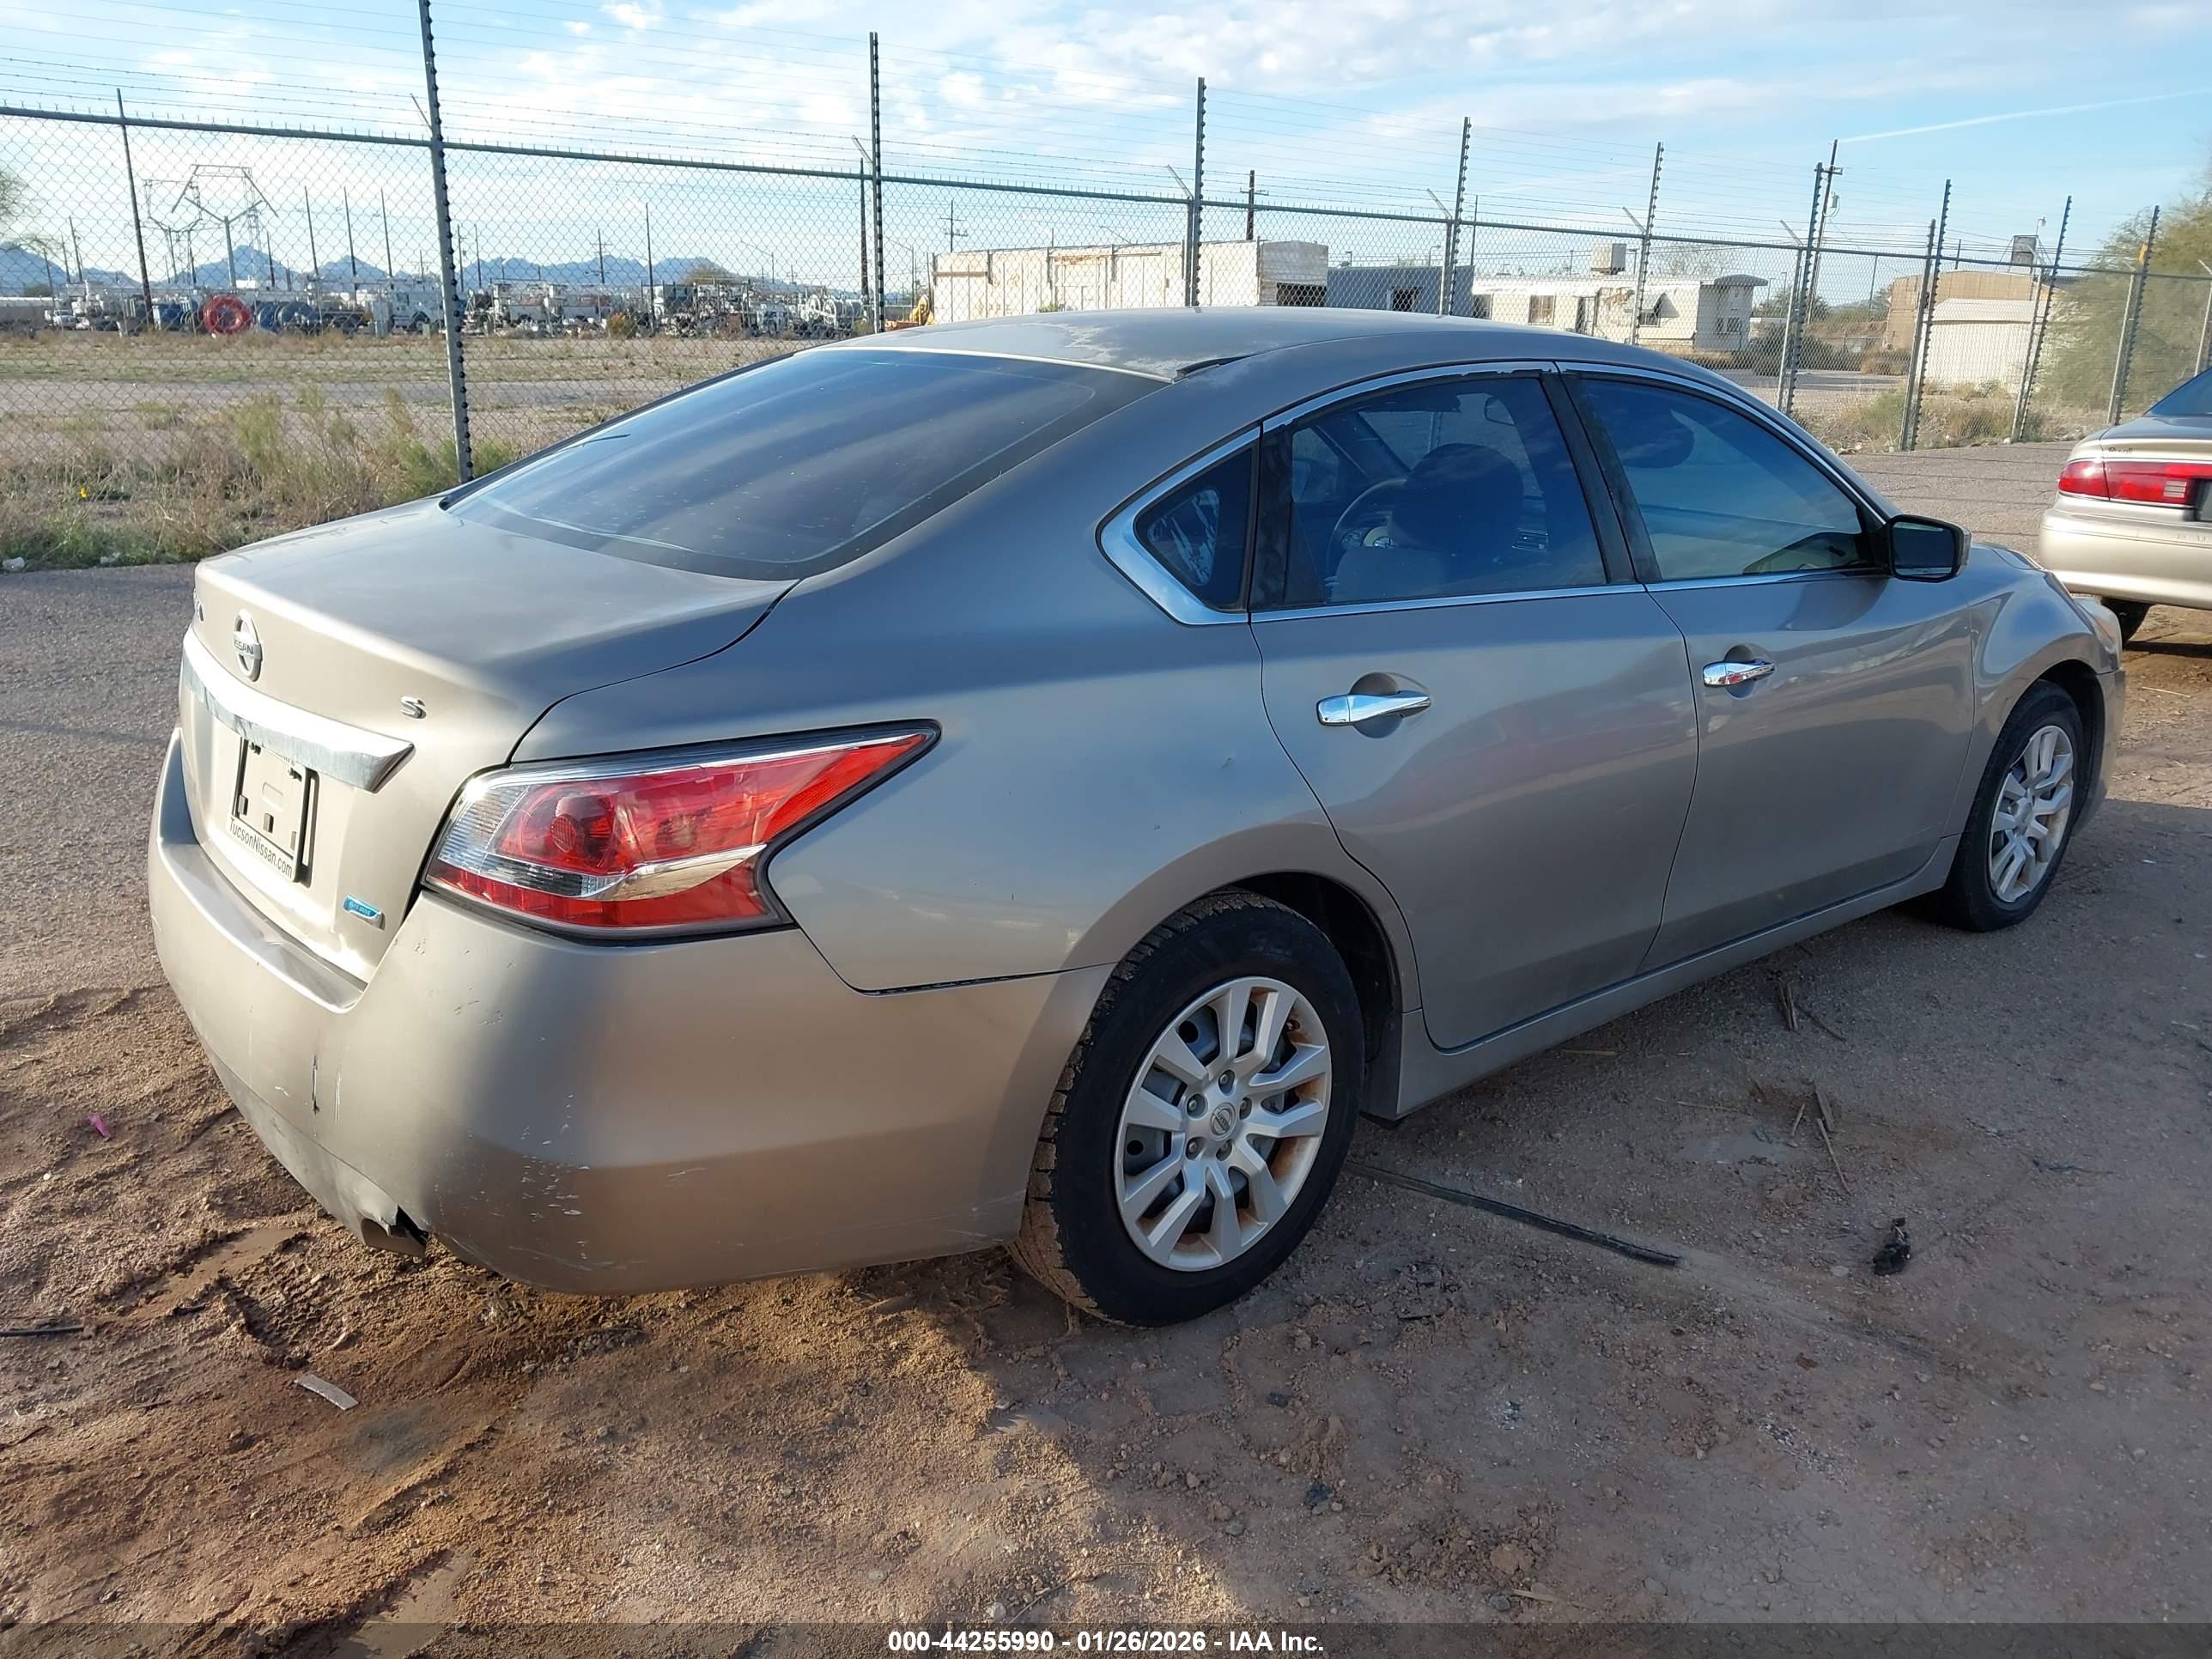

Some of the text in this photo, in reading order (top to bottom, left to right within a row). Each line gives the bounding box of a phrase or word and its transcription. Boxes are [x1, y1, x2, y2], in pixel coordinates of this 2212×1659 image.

[234, 638, 254, 655] SSAN
[400, 696, 427, 720] S
[229, 816, 293, 878] TucsonNissan.com
